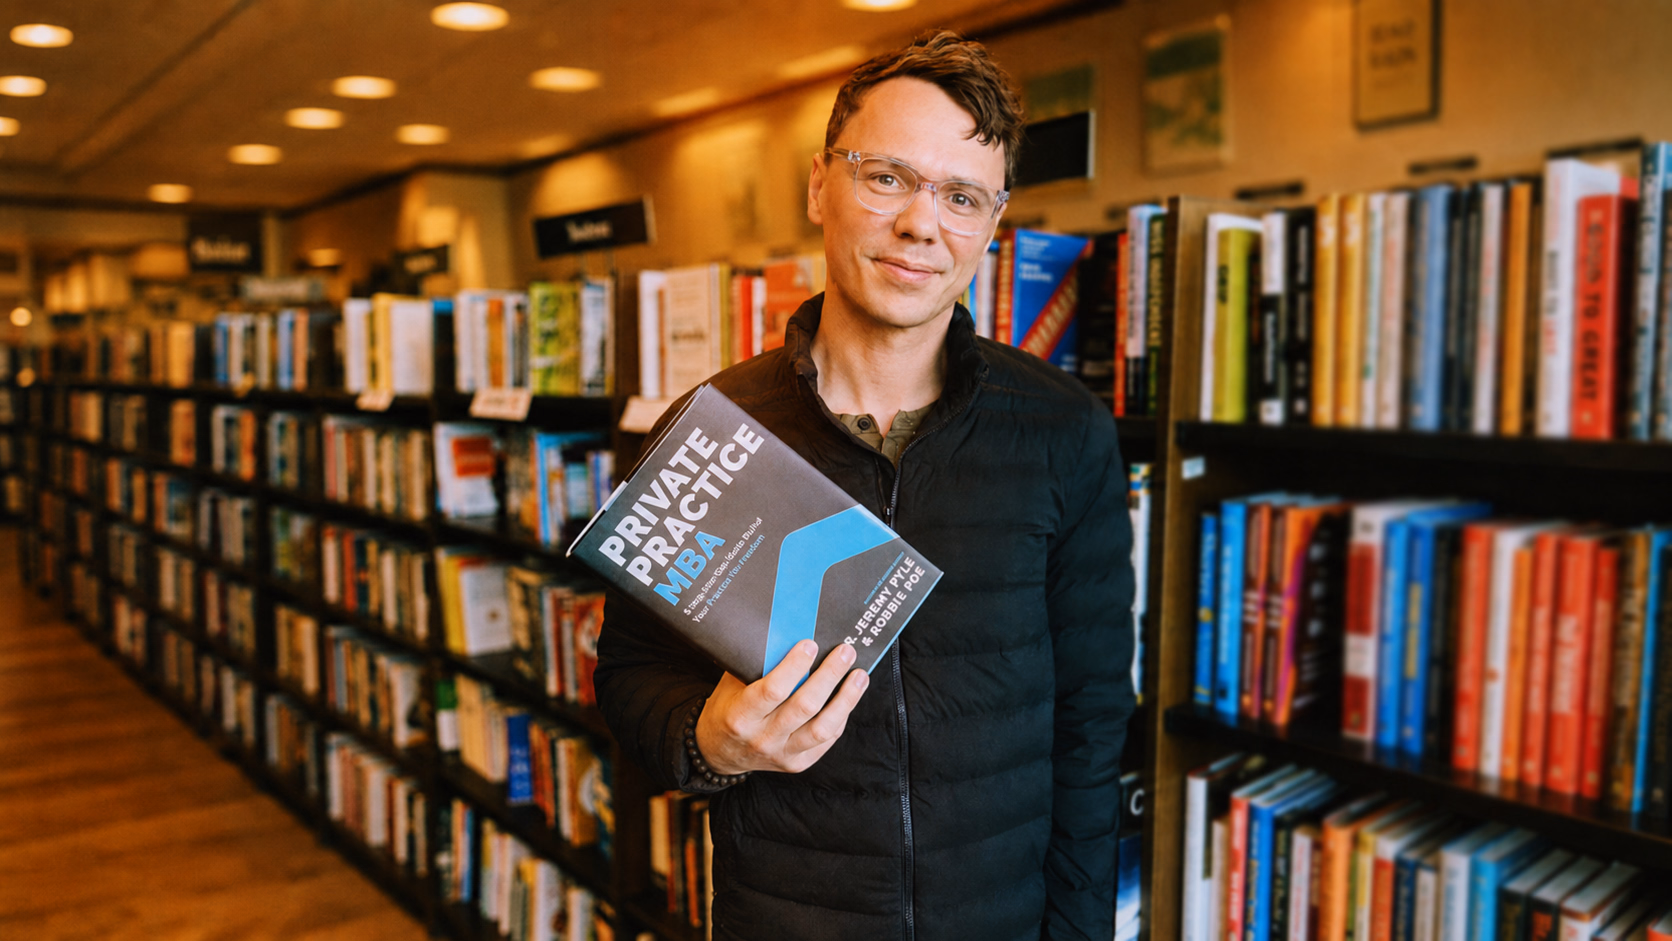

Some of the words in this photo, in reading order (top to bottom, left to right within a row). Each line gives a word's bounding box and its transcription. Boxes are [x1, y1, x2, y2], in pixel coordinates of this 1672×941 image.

[1583, 293, 1601, 319] TO
[1580, 330, 1600, 400] GREAT
[598, 426, 719, 567] PRIVATE
[626, 423, 765, 587] PRACTICE
[653, 530, 726, 607] MBA
[854, 586, 892, 635] JEREMY
[889, 557, 915, 587] PYLE
[862, 637, 873, 646] &
[870, 590, 907, 637] ROBBIE
[904, 566, 925, 591] POE
[692, 603, 711, 624] Your
